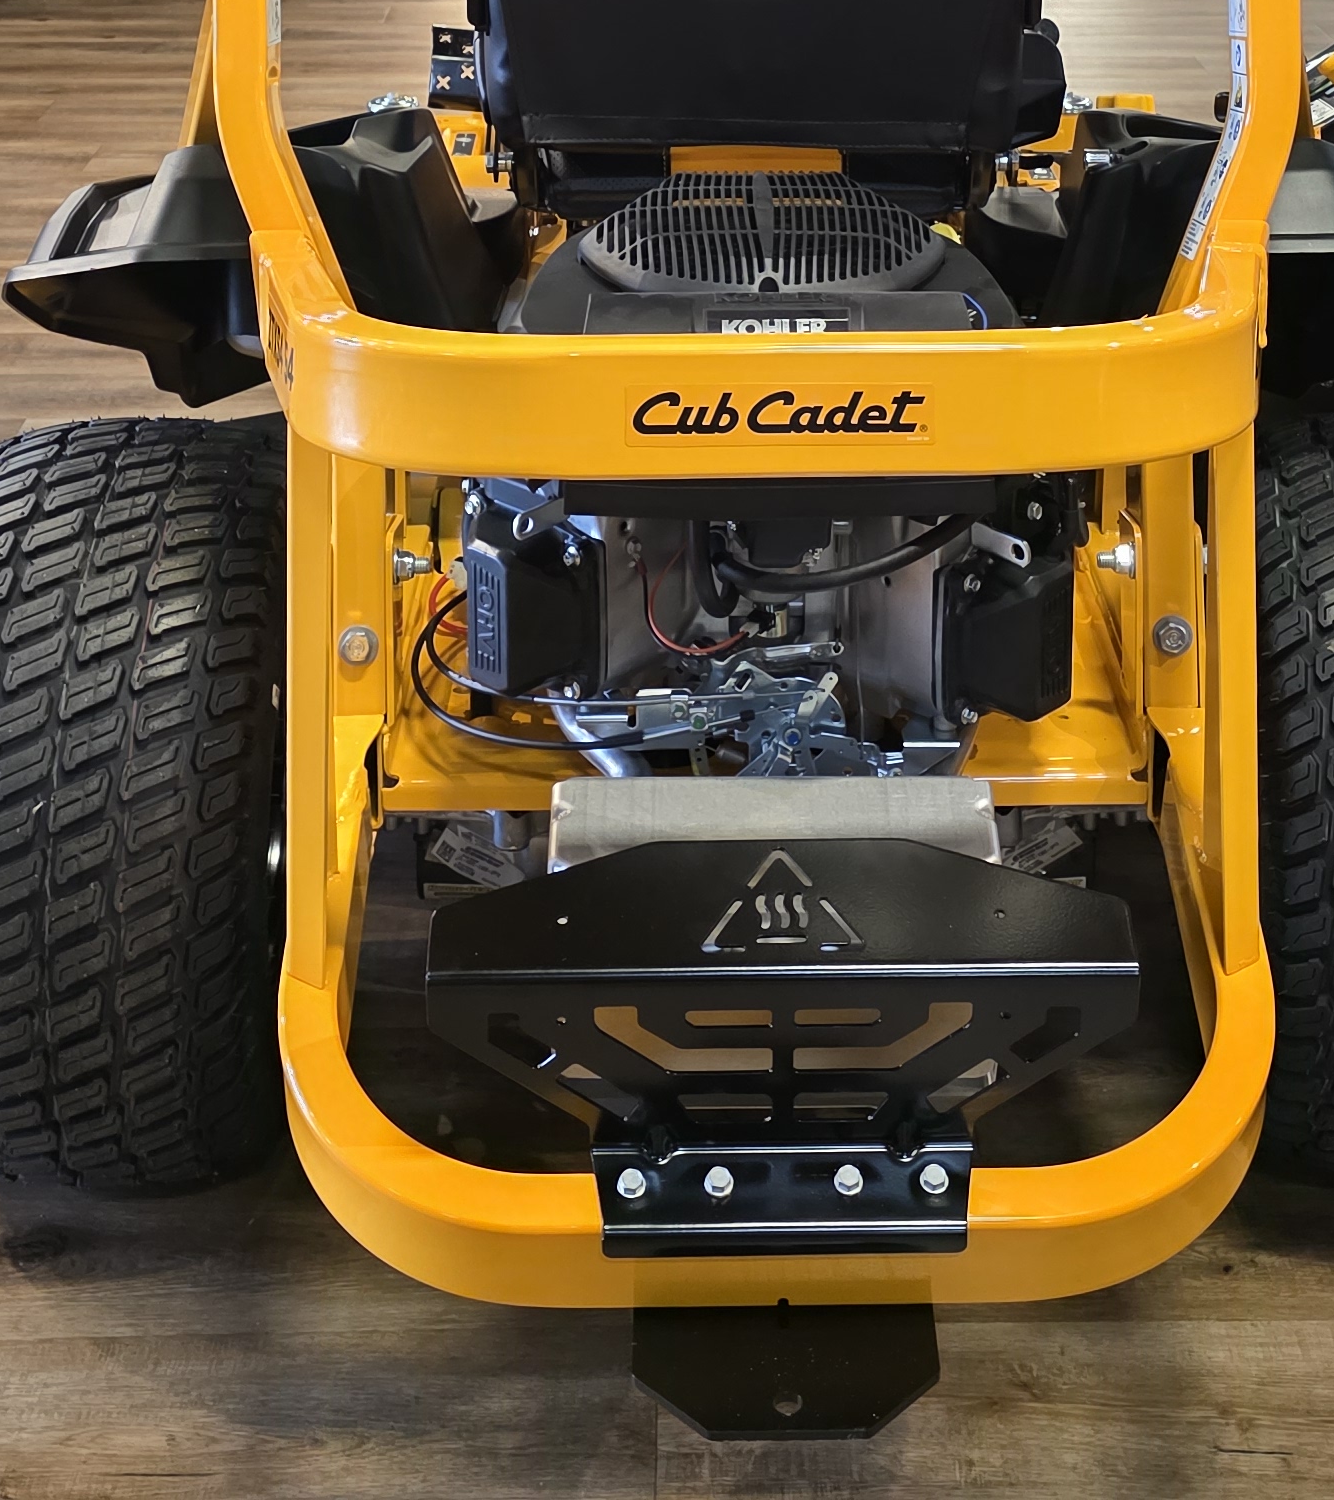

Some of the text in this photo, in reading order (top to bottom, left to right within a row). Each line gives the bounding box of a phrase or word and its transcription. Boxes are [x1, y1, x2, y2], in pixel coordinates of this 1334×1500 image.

[722, 318, 827, 334] KOHLER
[632, 390, 926, 435] Cub Cadet
